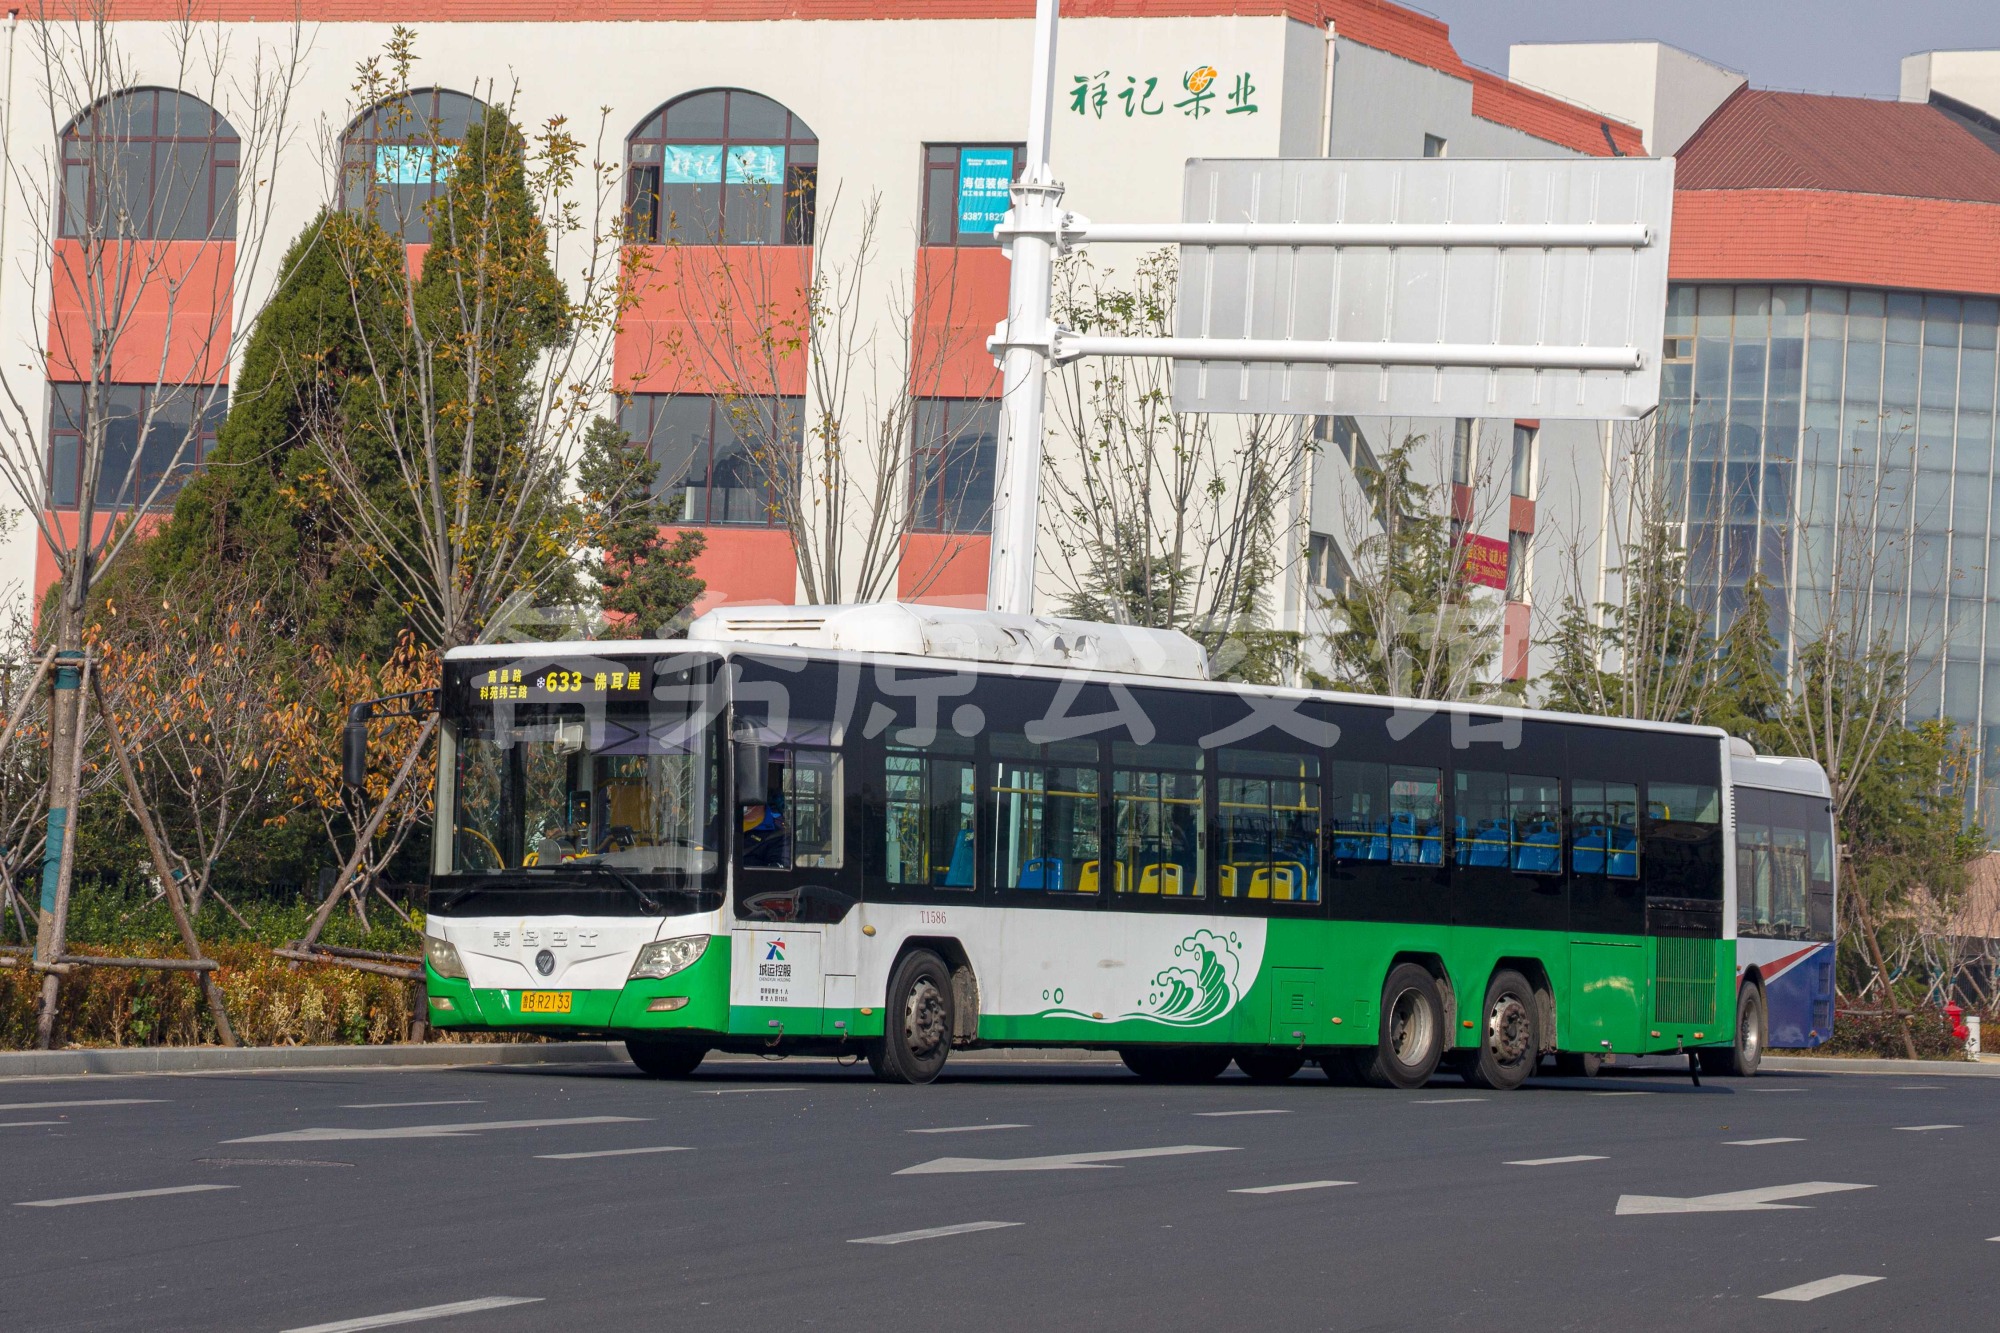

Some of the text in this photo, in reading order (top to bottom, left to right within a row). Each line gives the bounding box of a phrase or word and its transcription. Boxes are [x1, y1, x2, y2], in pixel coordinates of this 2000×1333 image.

[1069, 65, 1258, 120] 祥记果业
[963, 177, 1008, 189] 海信装修
[488, 669, 522, 683] 高昌路
[546, 671, 582, 692] 633
[594, 672, 641, 690] 佛耳崖
[480, 686, 528, 700] 科苑纬三路
[920, 911, 947, 924] T1586
[759, 964, 791, 977] 城运控股
